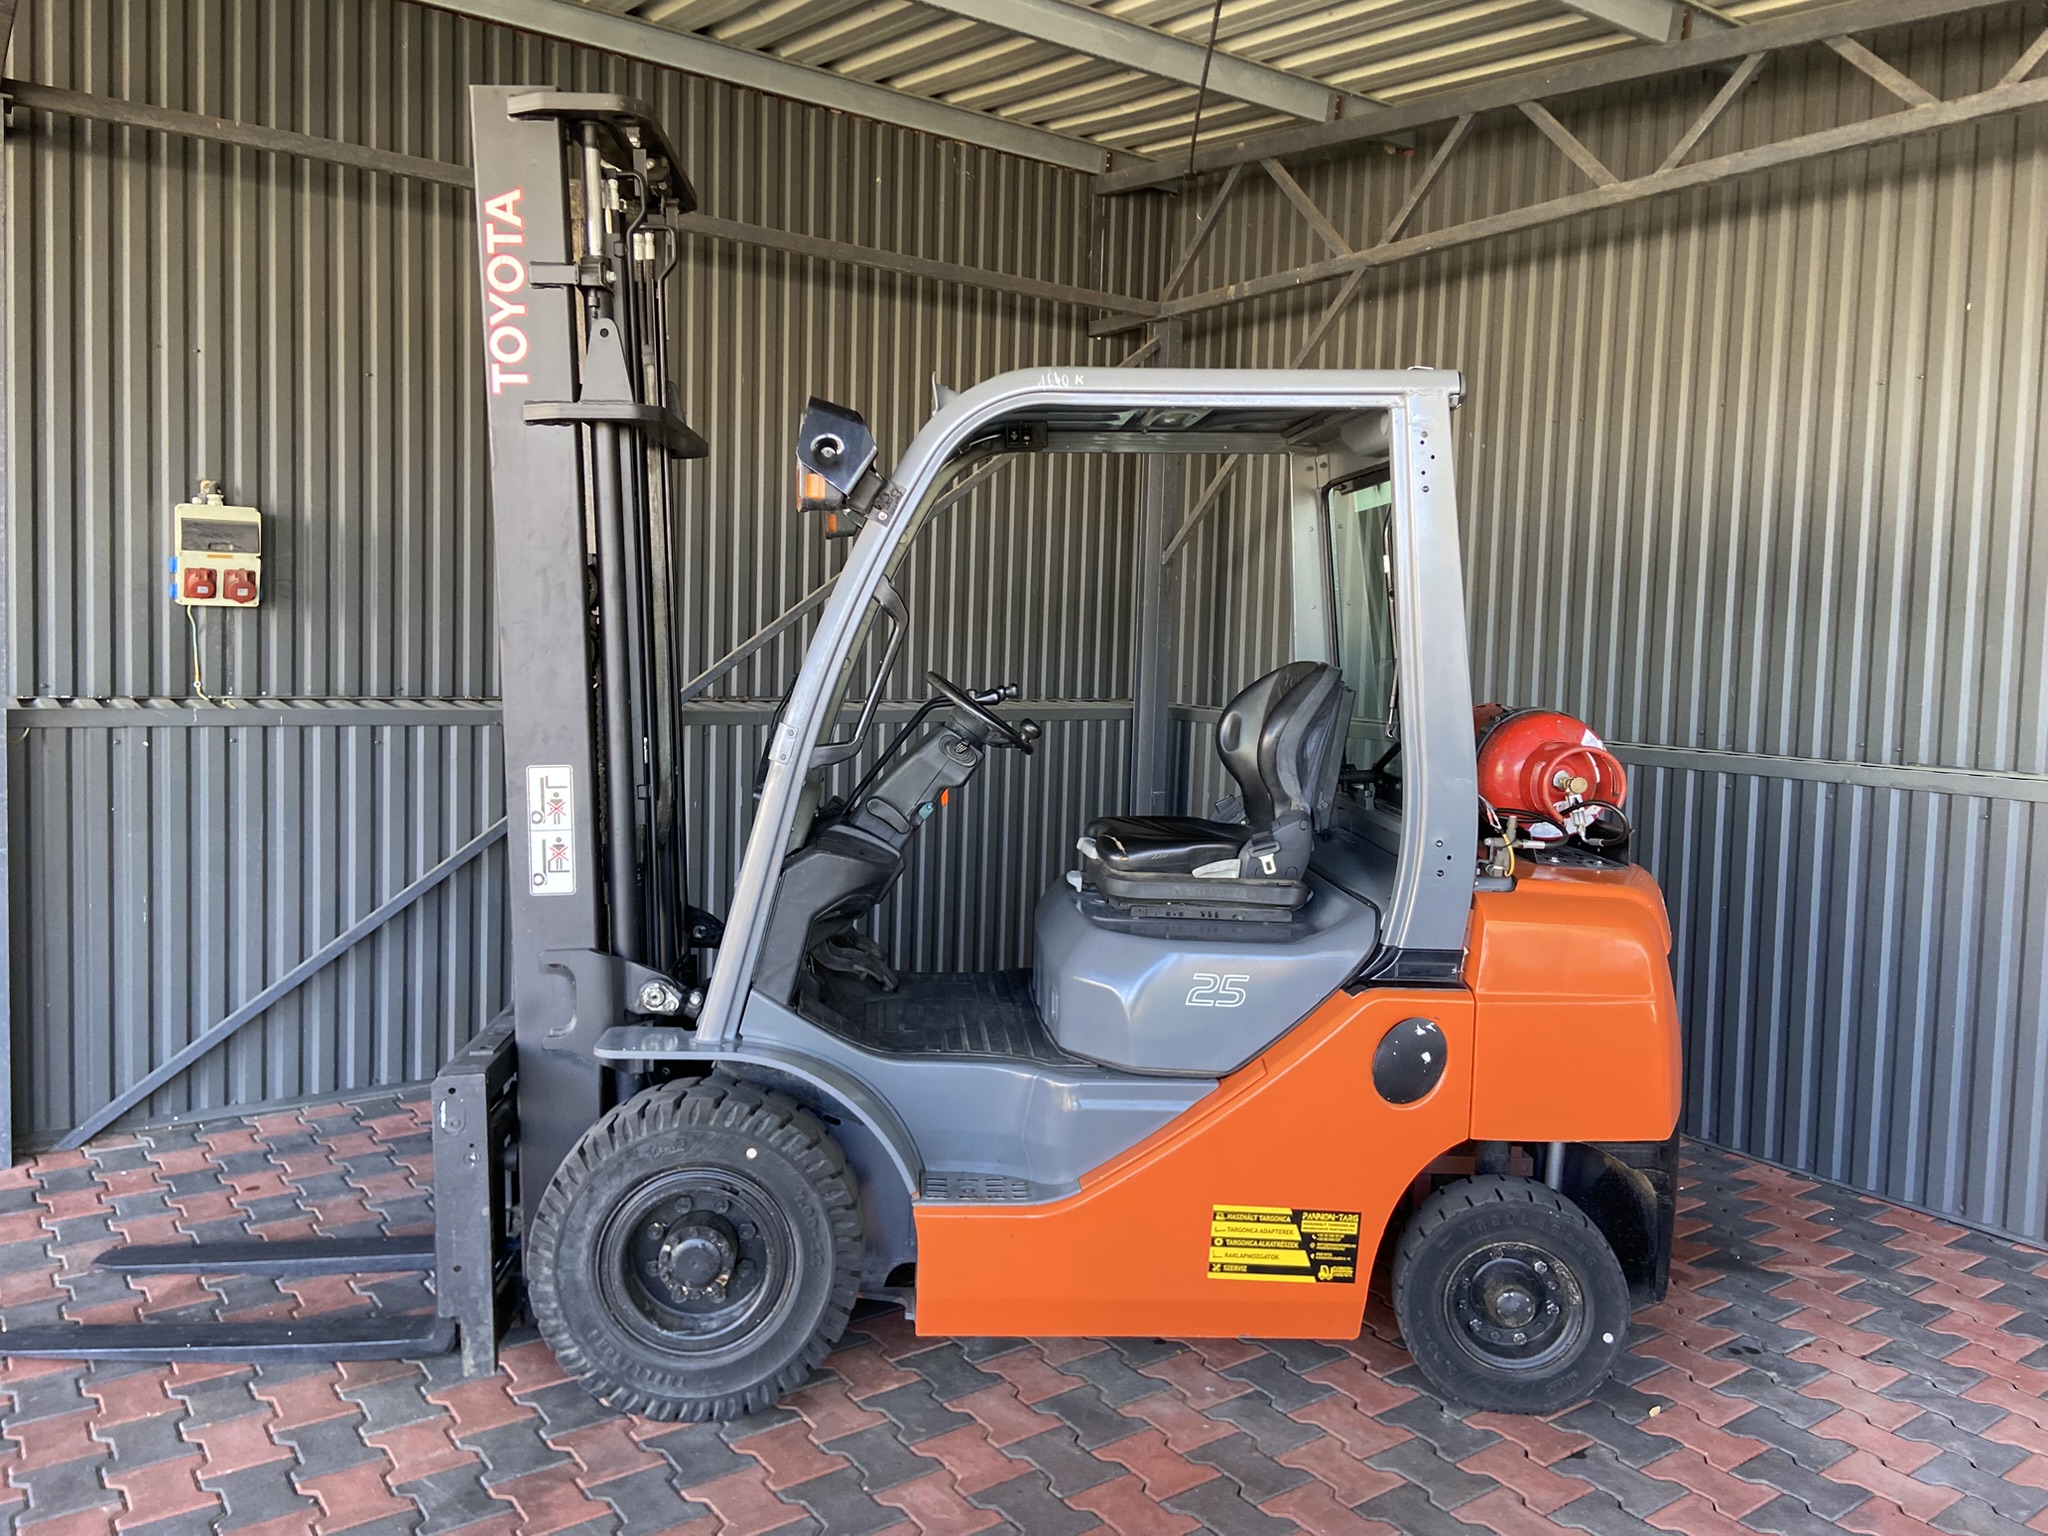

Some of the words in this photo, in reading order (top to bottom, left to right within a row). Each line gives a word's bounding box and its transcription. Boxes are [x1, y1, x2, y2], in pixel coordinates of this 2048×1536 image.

[485, 186, 530, 395] TOYOTA
[1185, 973, 1250, 1007] 25
[1259, 1215, 1291, 1223] TARGONCA
[1227, 1226, 1258, 1234] TARGONCA
[1259, 1228, 1294, 1236] ADAPTEREK
[1225, 1239, 1258, 1247] TARGONCA
